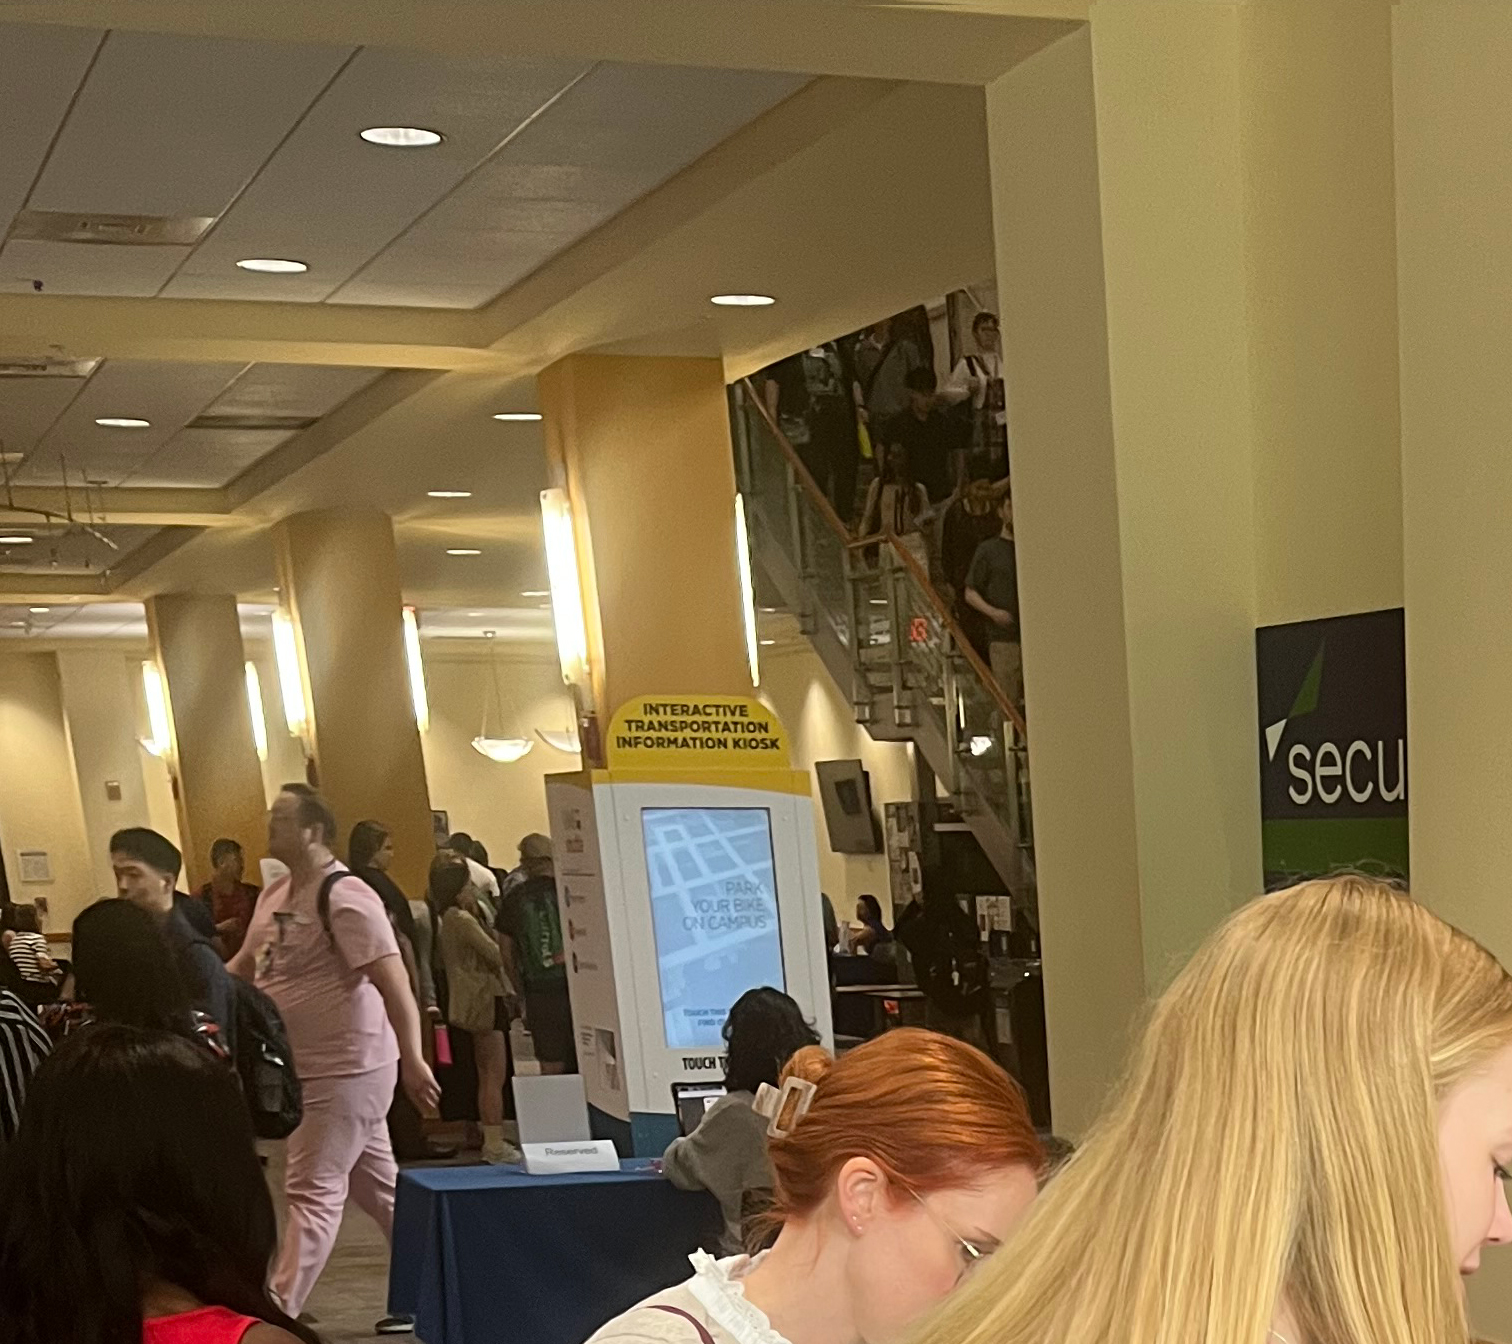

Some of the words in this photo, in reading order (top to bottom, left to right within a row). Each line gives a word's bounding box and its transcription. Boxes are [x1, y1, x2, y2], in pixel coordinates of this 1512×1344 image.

[643, 703, 749, 718] INTERACTIVE
[624, 719, 769, 734] TRANSPORTATION
[616, 736, 728, 750] INFORMATION
[732, 737, 780, 750] KIOSK
[1288, 738, 1405, 805] secu
[692, 899, 730, 914] YOUR
[733, 898, 765, 912] BIKE
[708, 915, 767, 930] CAMPUS
[682, 1057, 717, 1071] TOUCH
[544, 1147, 599, 1156] Reserved
